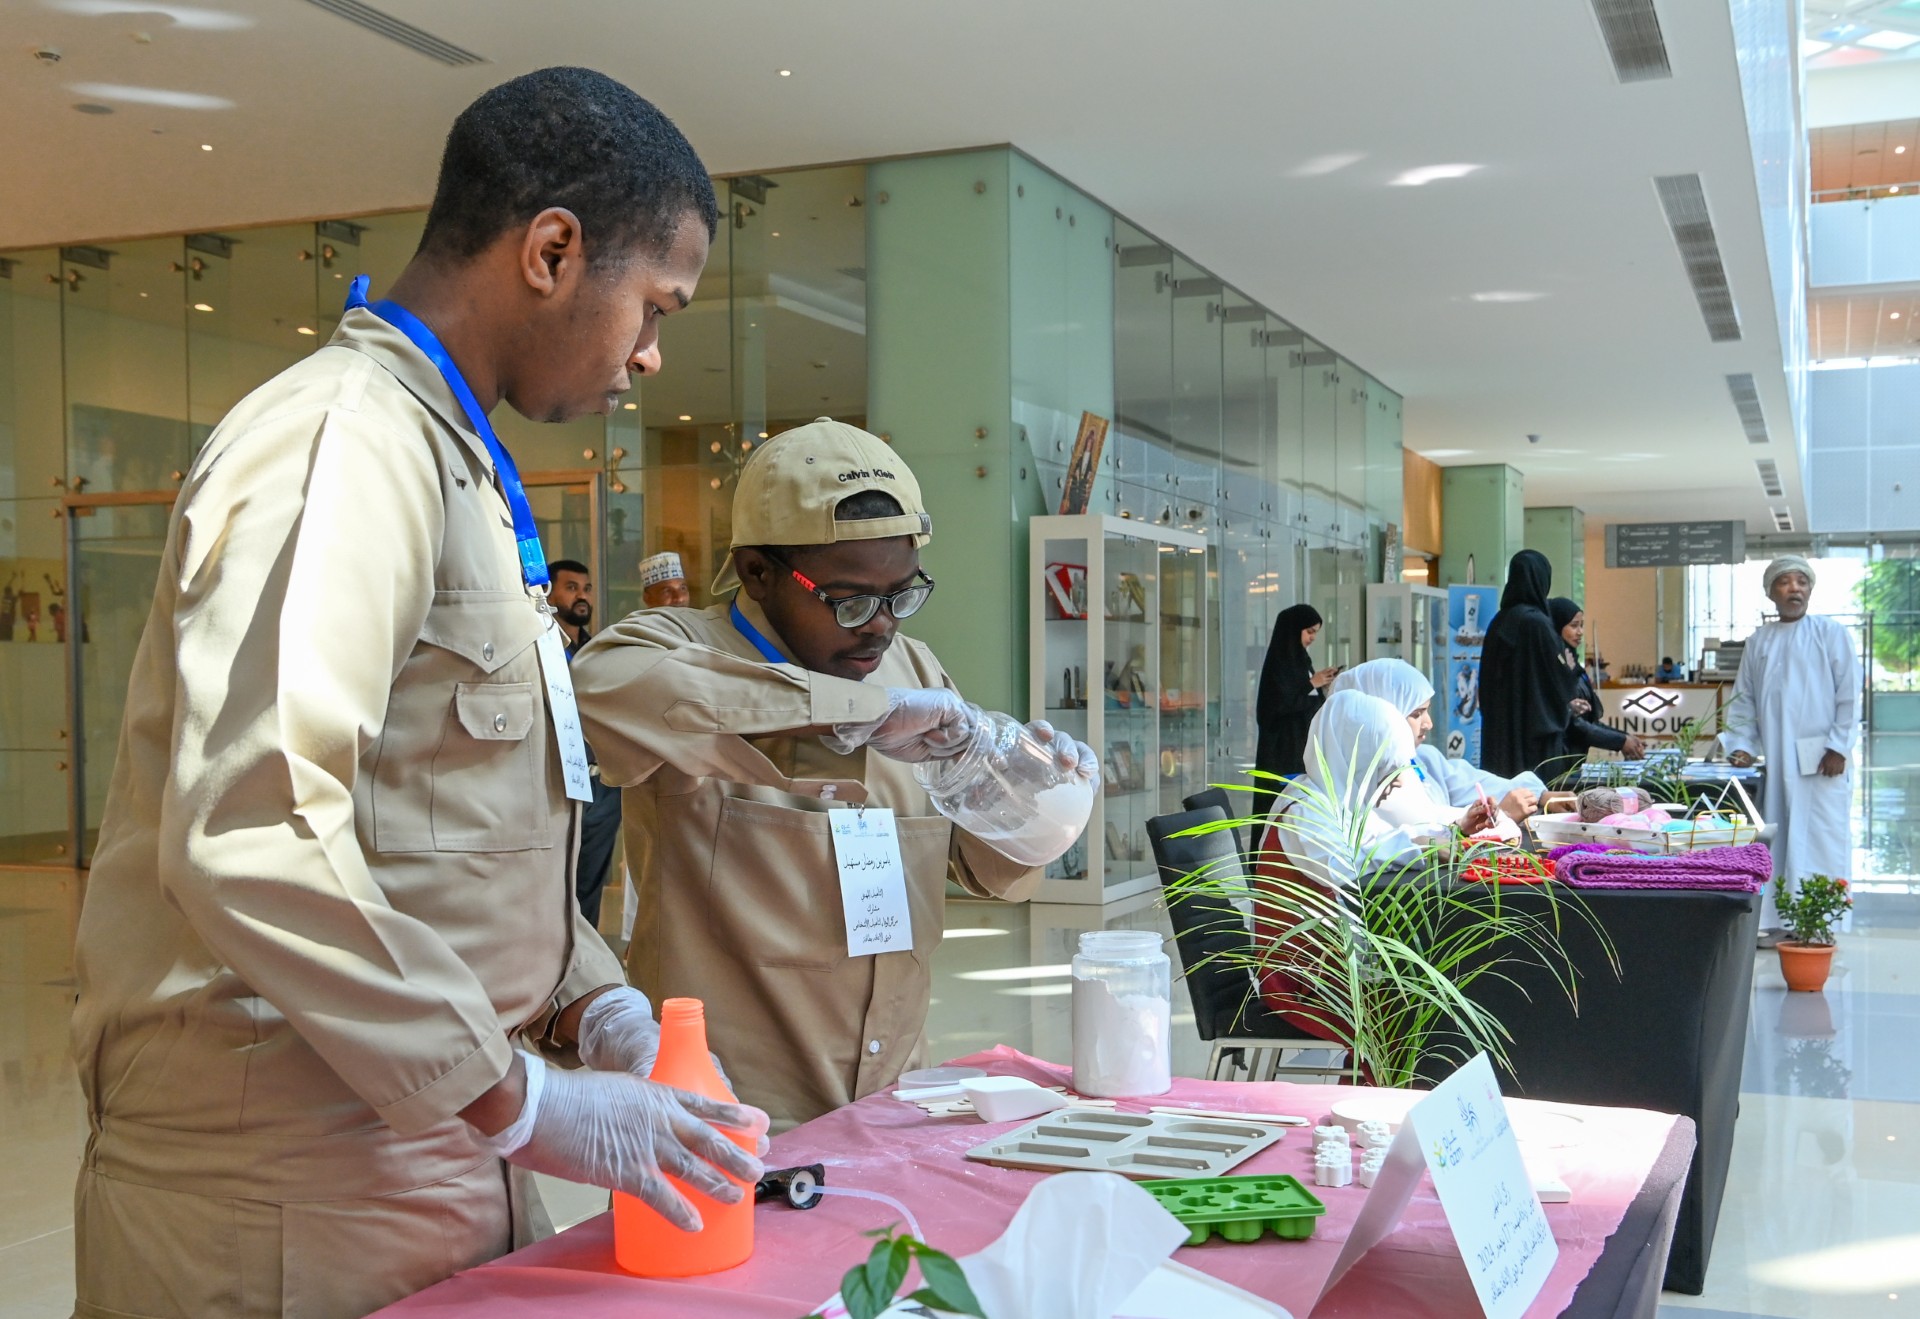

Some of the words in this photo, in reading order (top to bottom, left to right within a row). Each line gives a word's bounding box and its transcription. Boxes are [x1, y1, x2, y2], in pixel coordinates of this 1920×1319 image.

[838, 469, 870, 483] Calvin
[873, 468, 896, 481] Klein
[1449, 1146, 1465, 1166] azm
[1477, 1241, 1495, 1273] 2024
